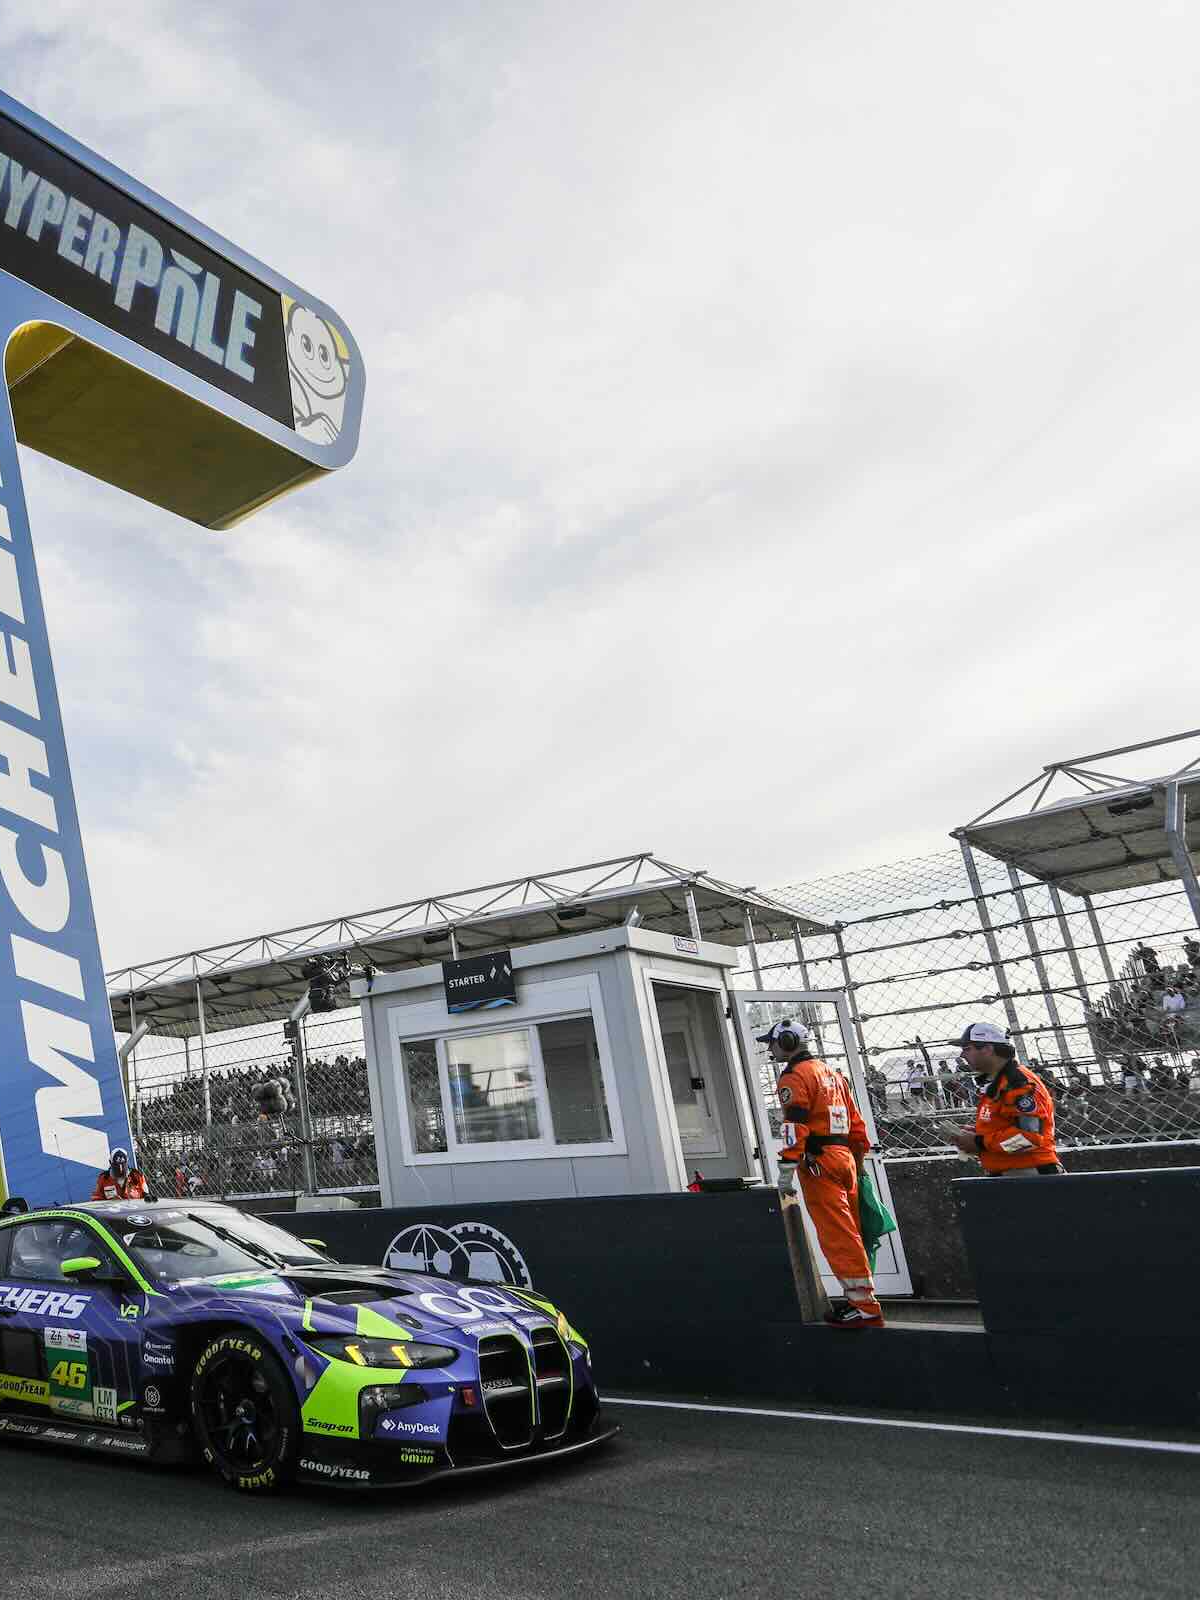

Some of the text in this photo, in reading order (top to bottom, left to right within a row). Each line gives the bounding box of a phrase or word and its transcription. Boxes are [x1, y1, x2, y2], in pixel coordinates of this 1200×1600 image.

[448, 974, 485, 989] STARTER
[143, 1353, 175, 1365] Omantel
[195, 1338, 262, 1376] GOODYEAR
[50, 1360, 88, 1390] 46
[306, 1417, 354, 1433] Snap-on
[397, 1421, 441, 1434] AnyDesk
[299, 1459, 371, 1480] GOODYEAR
